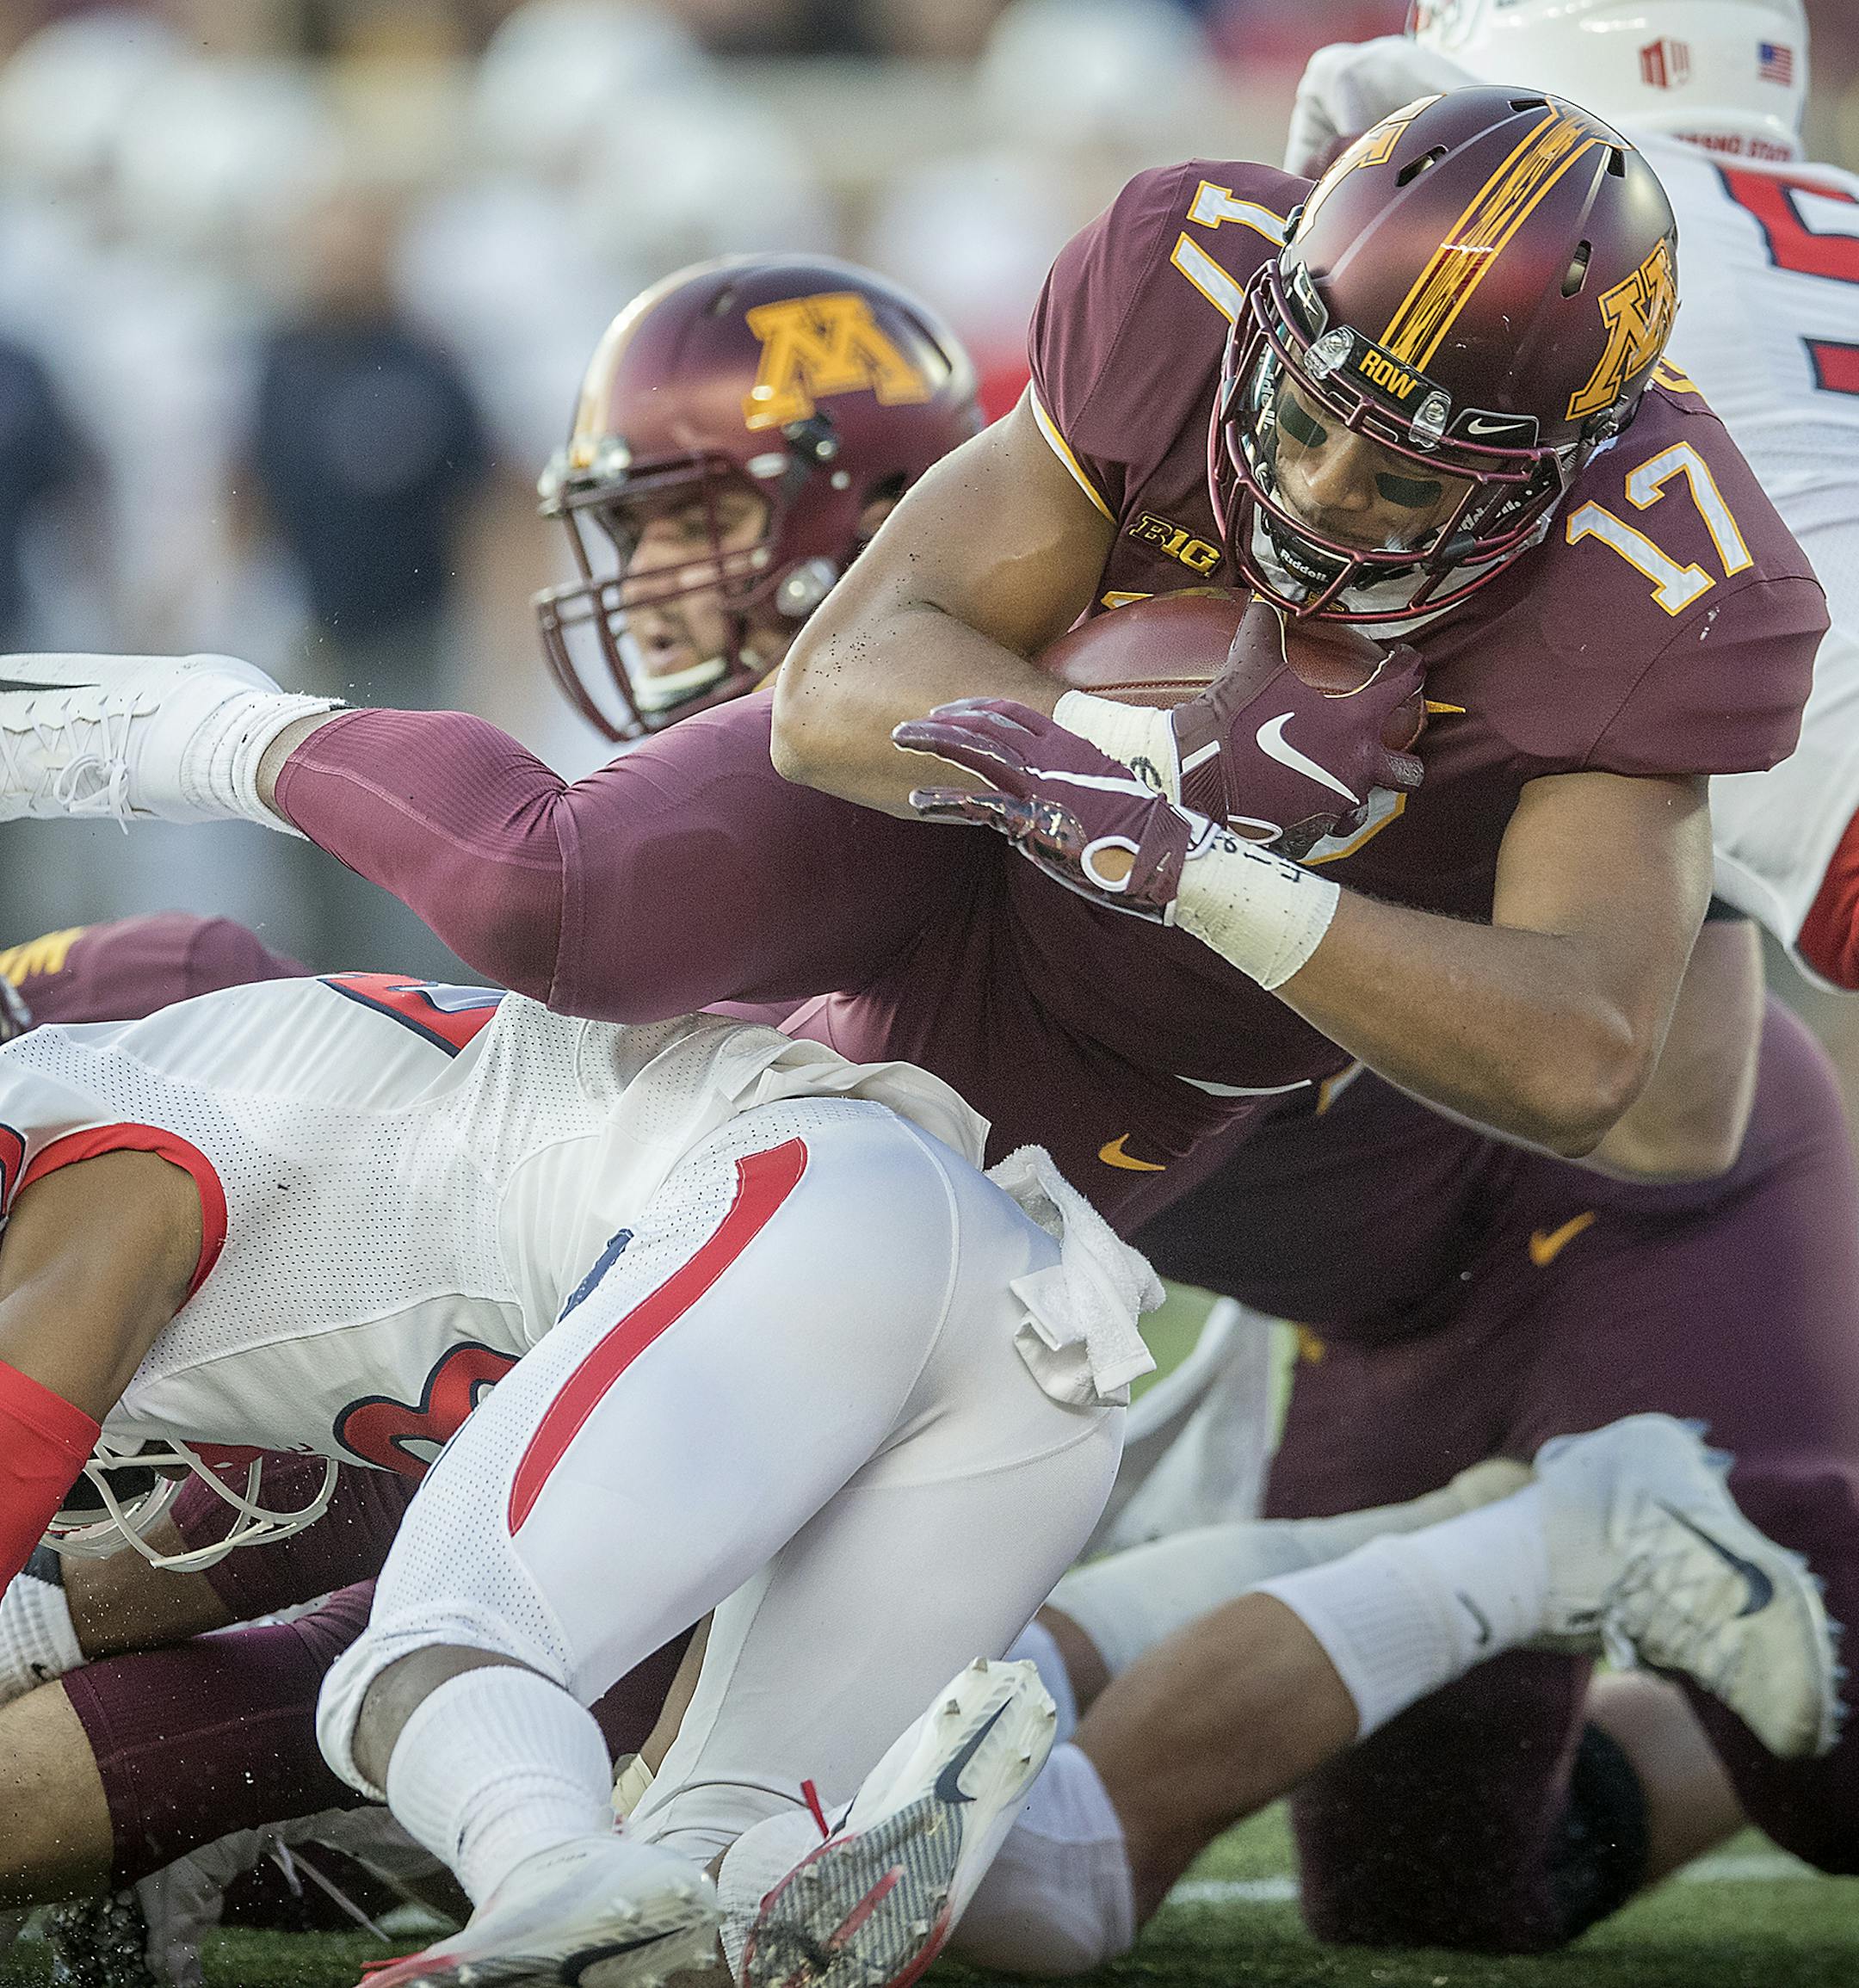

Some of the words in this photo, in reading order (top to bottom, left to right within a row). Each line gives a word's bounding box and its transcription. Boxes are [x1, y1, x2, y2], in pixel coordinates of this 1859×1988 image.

[742, 292, 932, 430] M
[1358, 349, 1418, 399] ROW
[1566, 441, 1753, 617] 17
